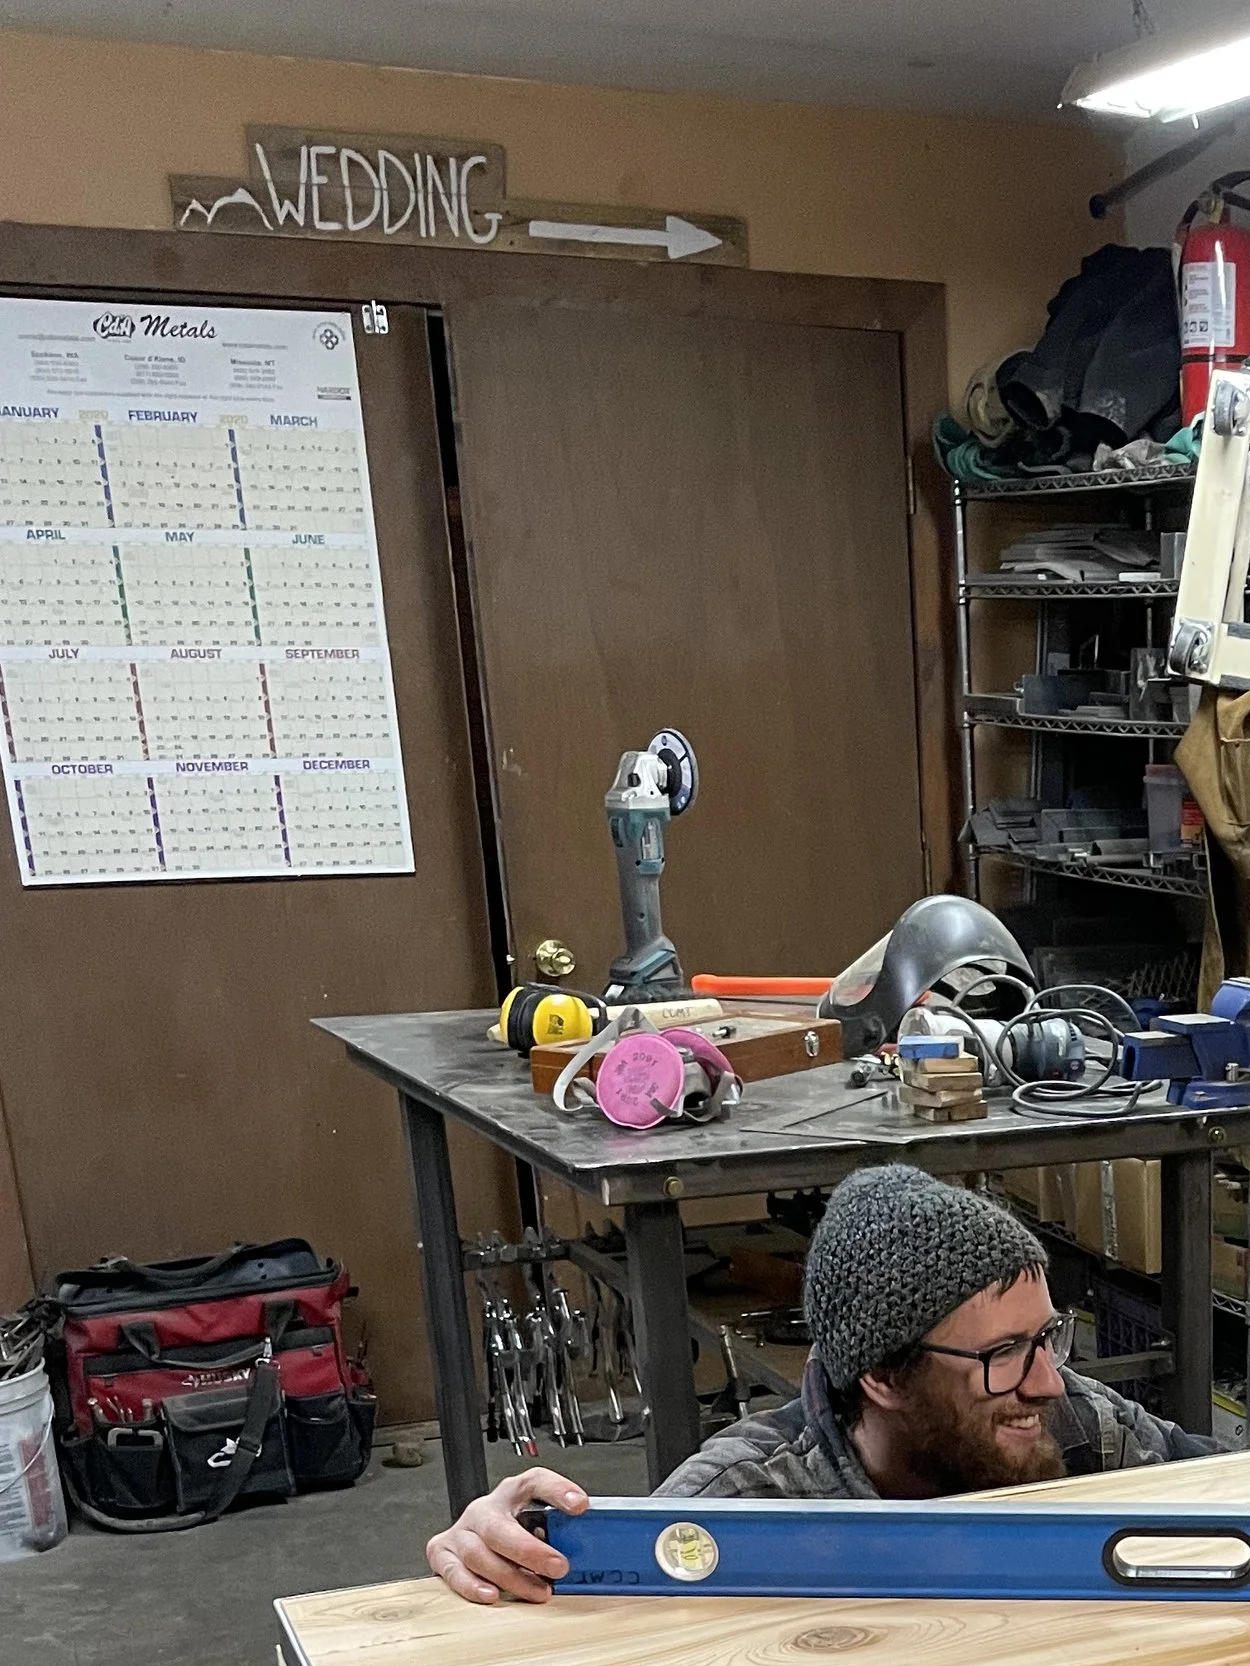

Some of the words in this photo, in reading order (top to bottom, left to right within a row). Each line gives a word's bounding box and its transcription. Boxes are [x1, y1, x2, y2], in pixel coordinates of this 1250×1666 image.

[255, 142, 502, 245] WEDDING
[140, 314, 217, 338] Metals
[0, 406, 59, 418] ANUARY
[128, 410, 198, 422] FEBRUARY
[270, 415, 318, 427] MARCH
[27, 529, 66, 540] APRIL
[165, 531, 195, 542] MAY
[292, 534, 325, 545] JUNE
[48, 648, 79, 659] JULY
[170, 648, 222, 659] AUGUST
[285, 648, 360, 659] SEPTEMBER
[52, 764, 113, 775] OCTOBER
[175, 761, 249, 772] NOVEMBER
[303, 759, 370, 770] DECEMBER
